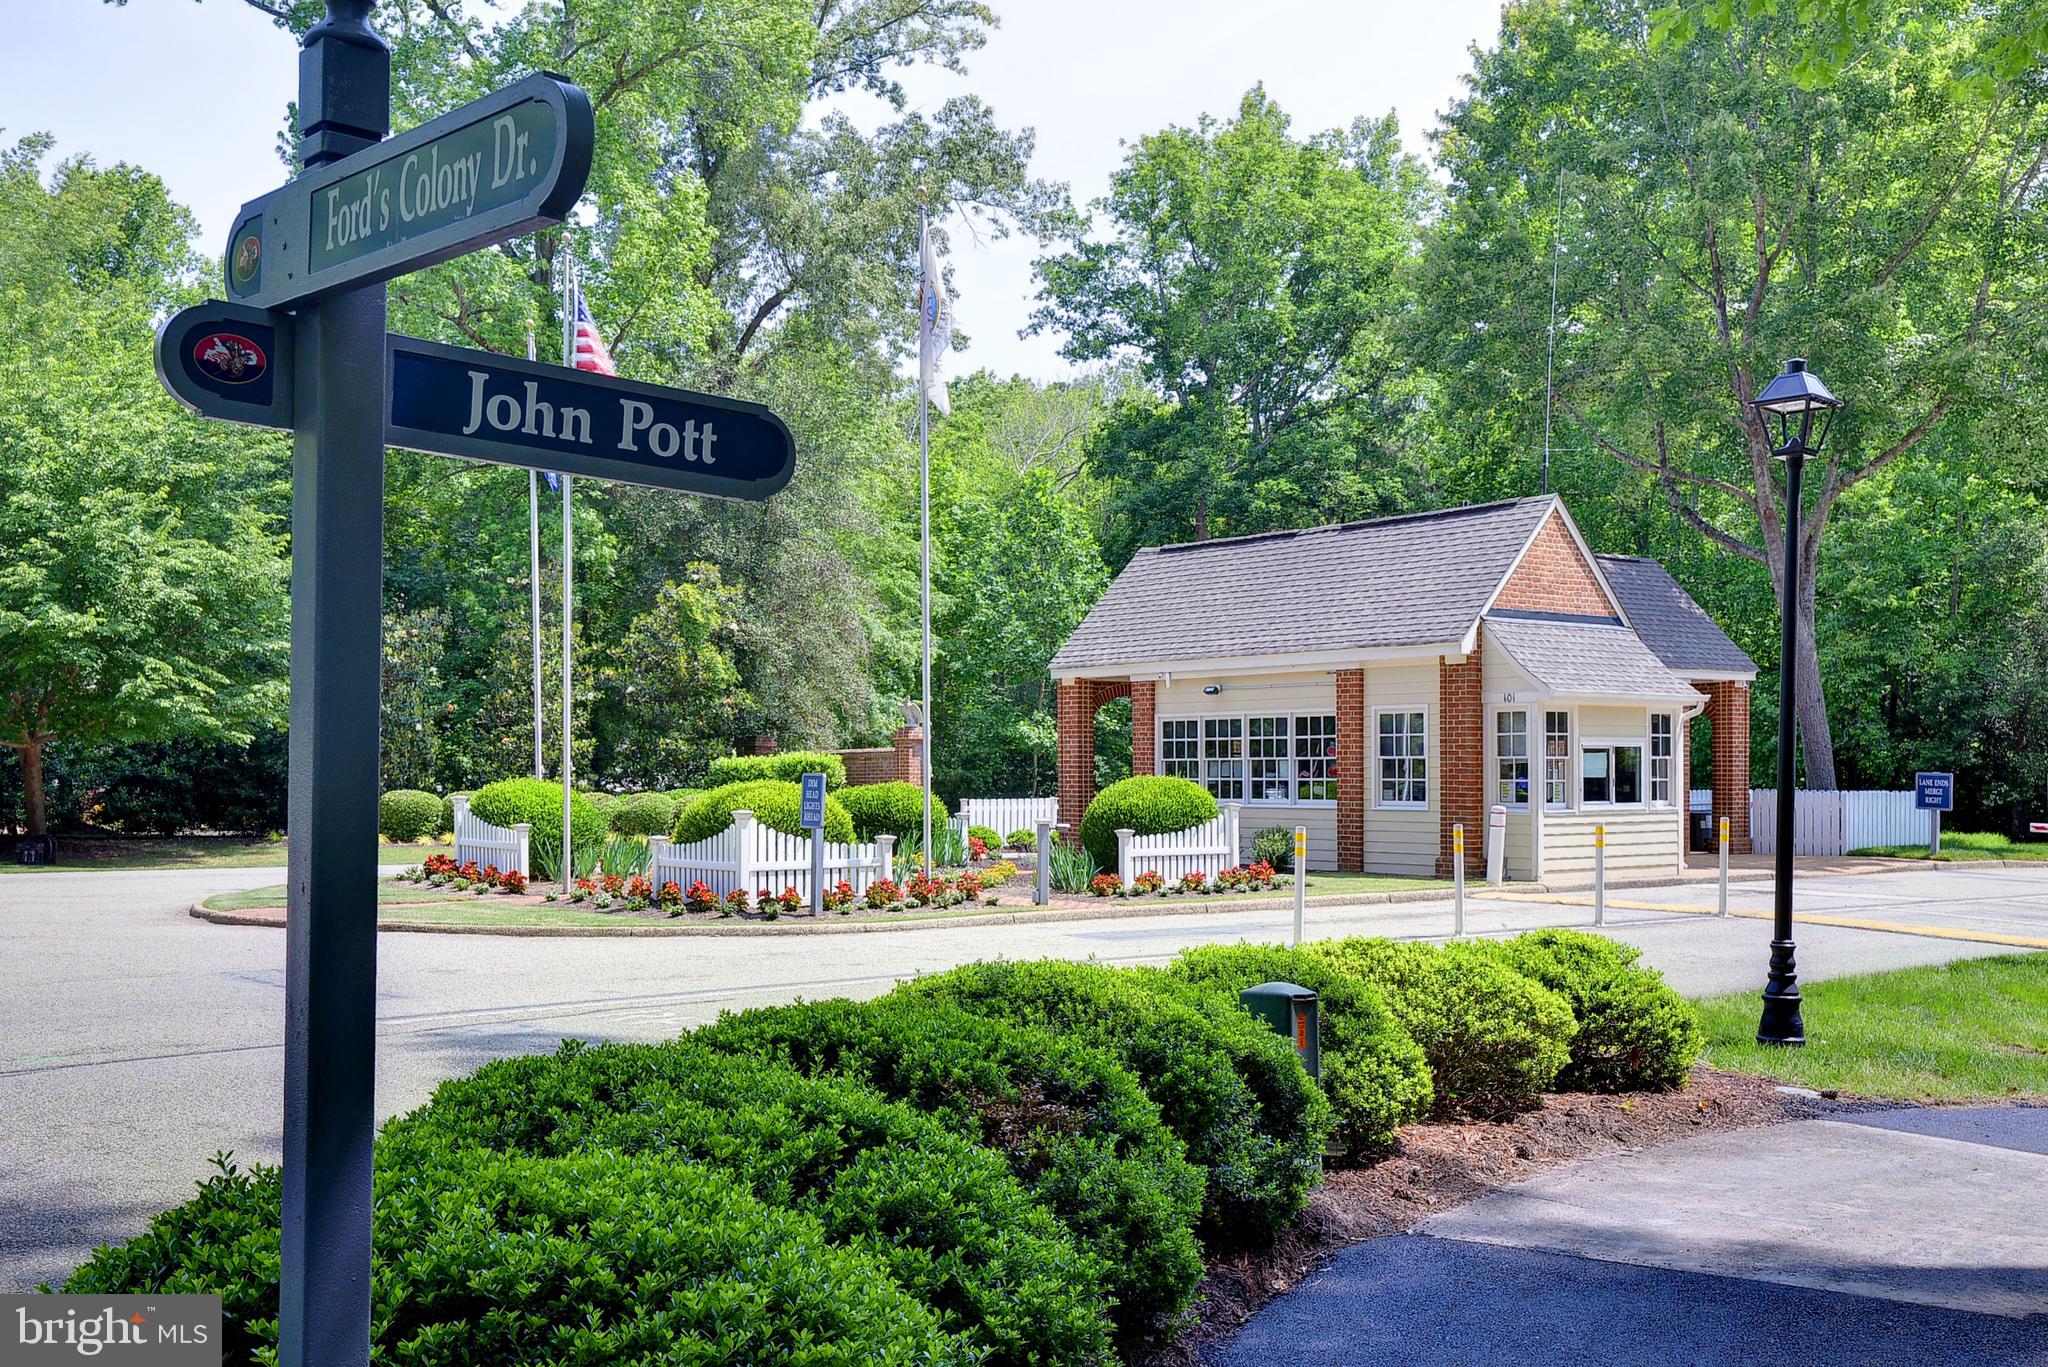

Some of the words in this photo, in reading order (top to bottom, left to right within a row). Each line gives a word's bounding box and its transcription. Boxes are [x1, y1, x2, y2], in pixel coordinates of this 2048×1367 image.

[326, 169, 390, 251] Ford's
[400, 144, 482, 222] Colony
[491, 115, 537, 190] Dr.
[462, 370, 593, 444] John
[617, 398, 718, 465] Pott
[1503, 692, 1516, 703] 101
[807, 778, 818, 788] DIM
[1919, 778, 1934, 786] LANE
[1934, 779, 1950, 787] ENDS
[805, 790, 820, 799] HEAD
[1924, 787, 1944, 796] MERGE
[1925, 796, 1943, 804] RIGHT
[803, 801, 821, 810] LIGHTS
[803, 812, 821, 821] AHEAD
